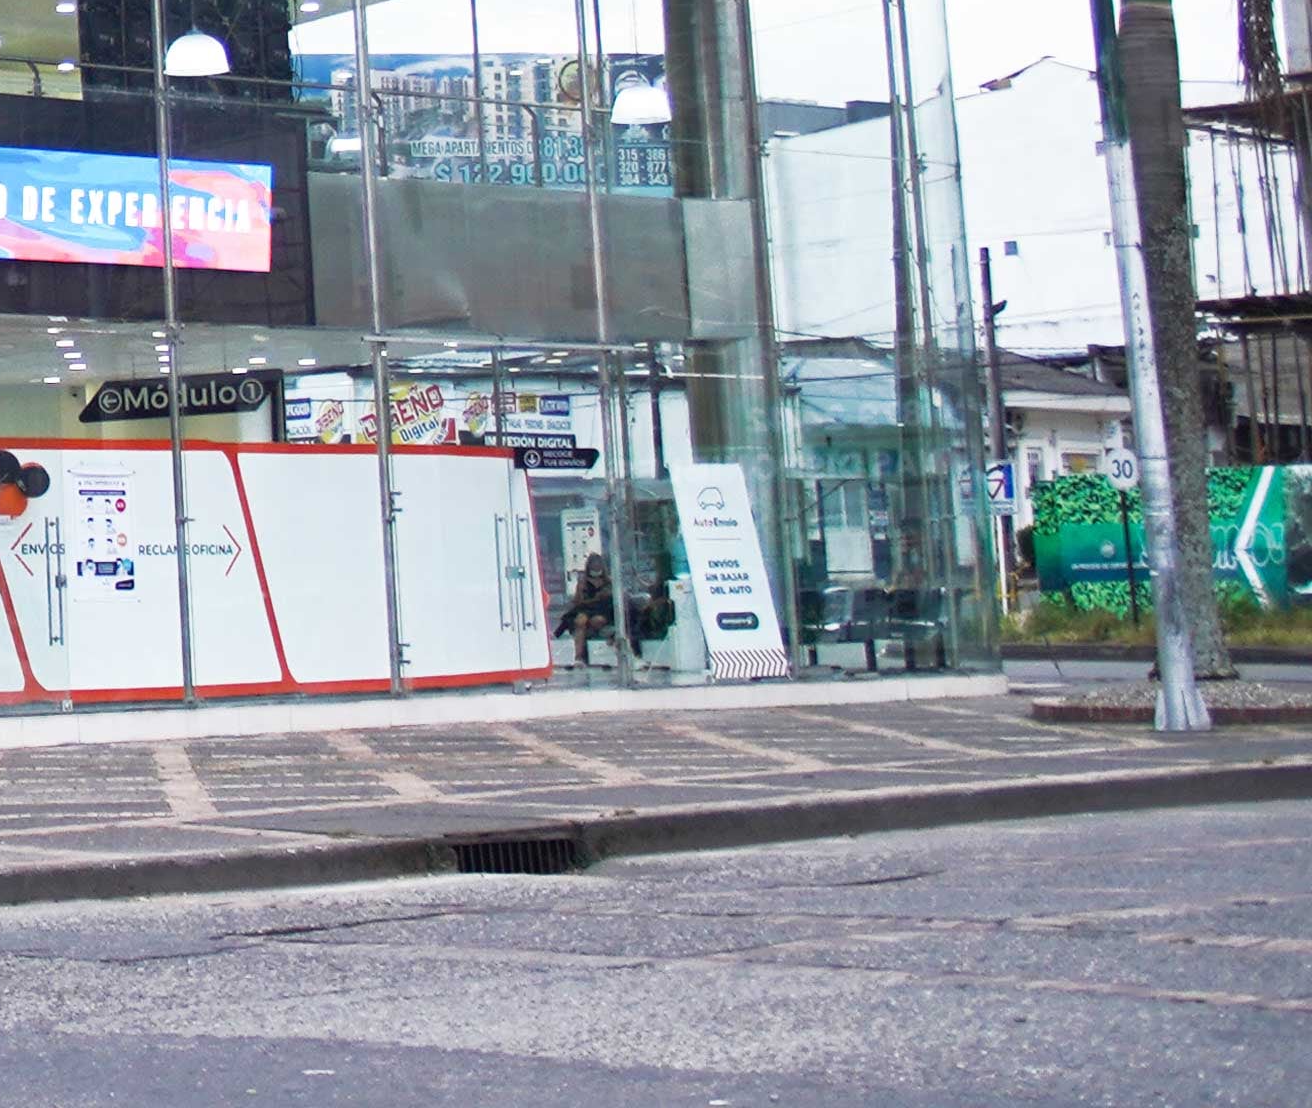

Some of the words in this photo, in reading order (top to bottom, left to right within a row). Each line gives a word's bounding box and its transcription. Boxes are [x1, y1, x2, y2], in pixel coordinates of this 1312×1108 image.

[22, 185, 56, 223] DE
[70, 188, 251, 234] EXPERENCIA
[125, 380, 236, 412] Módulo
[399, 417, 441, 443] Digital
[537, 437, 572, 448] DIGITAL
[1111, 460, 1133, 479] 30
[21, 543, 65, 555] ENVOS
[191, 543, 233, 556] OFICINA
